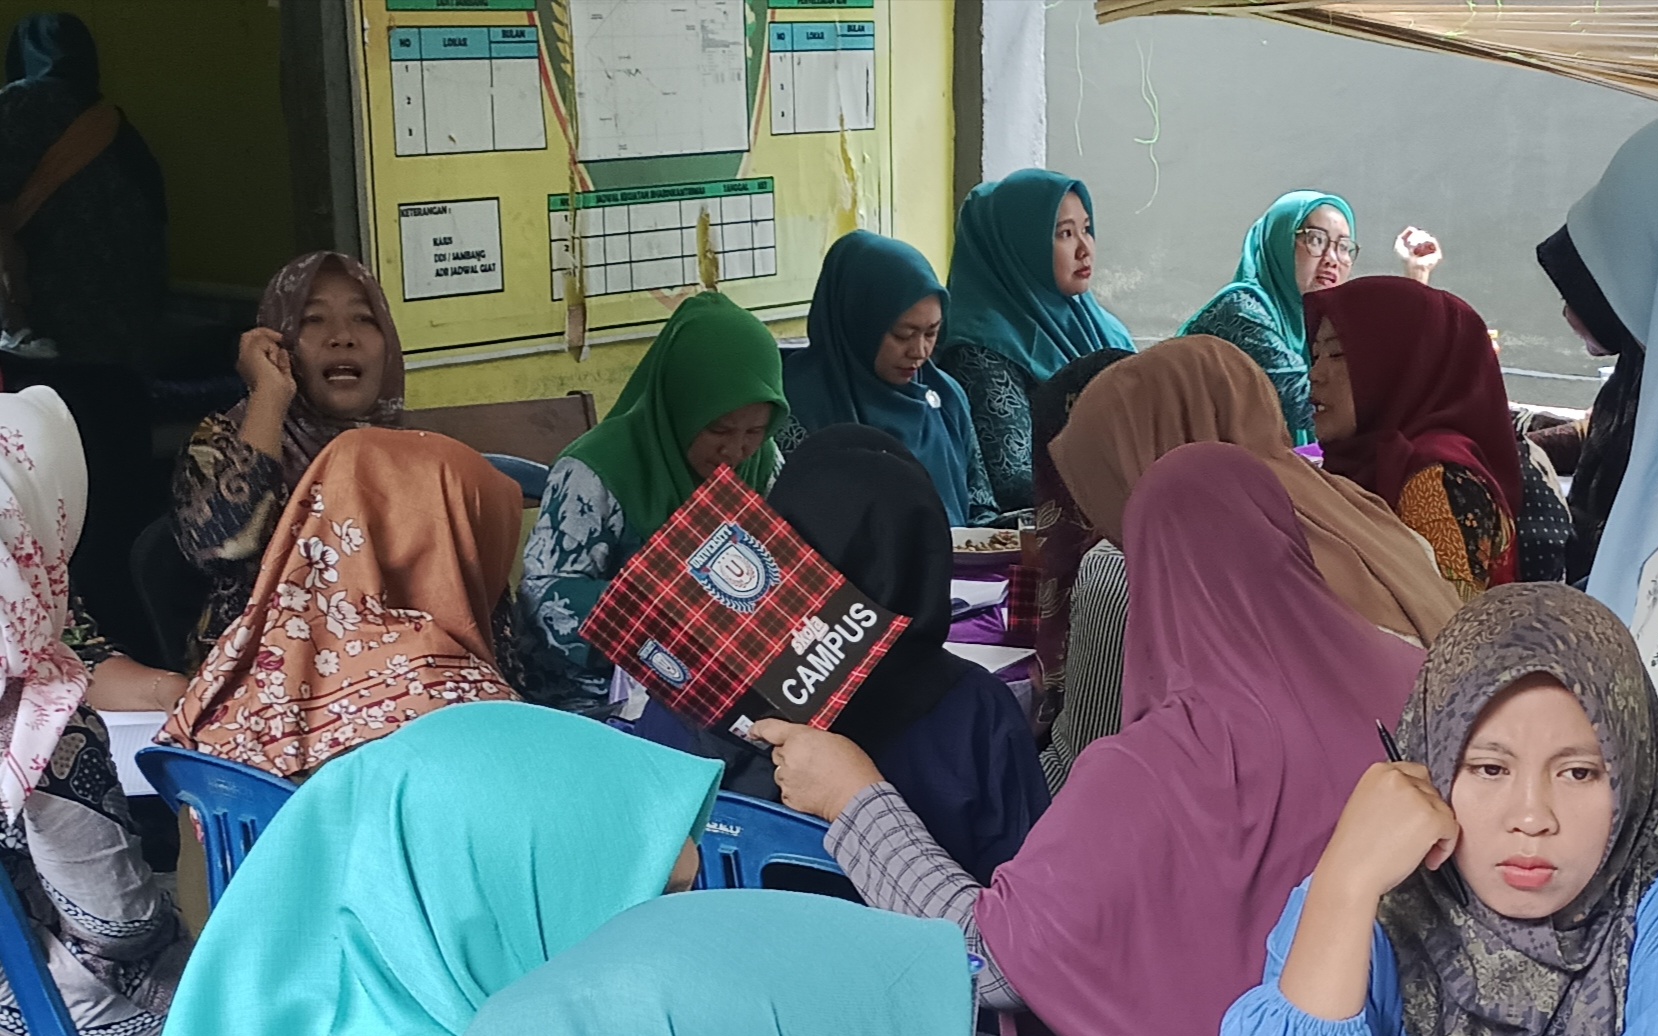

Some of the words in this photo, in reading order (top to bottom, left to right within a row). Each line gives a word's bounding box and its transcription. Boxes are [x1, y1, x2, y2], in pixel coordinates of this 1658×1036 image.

[689, 524, 733, 570] UNIVERSITY
[725, 560, 744, 577] U
[782, 602, 877, 705] CAMPUS
